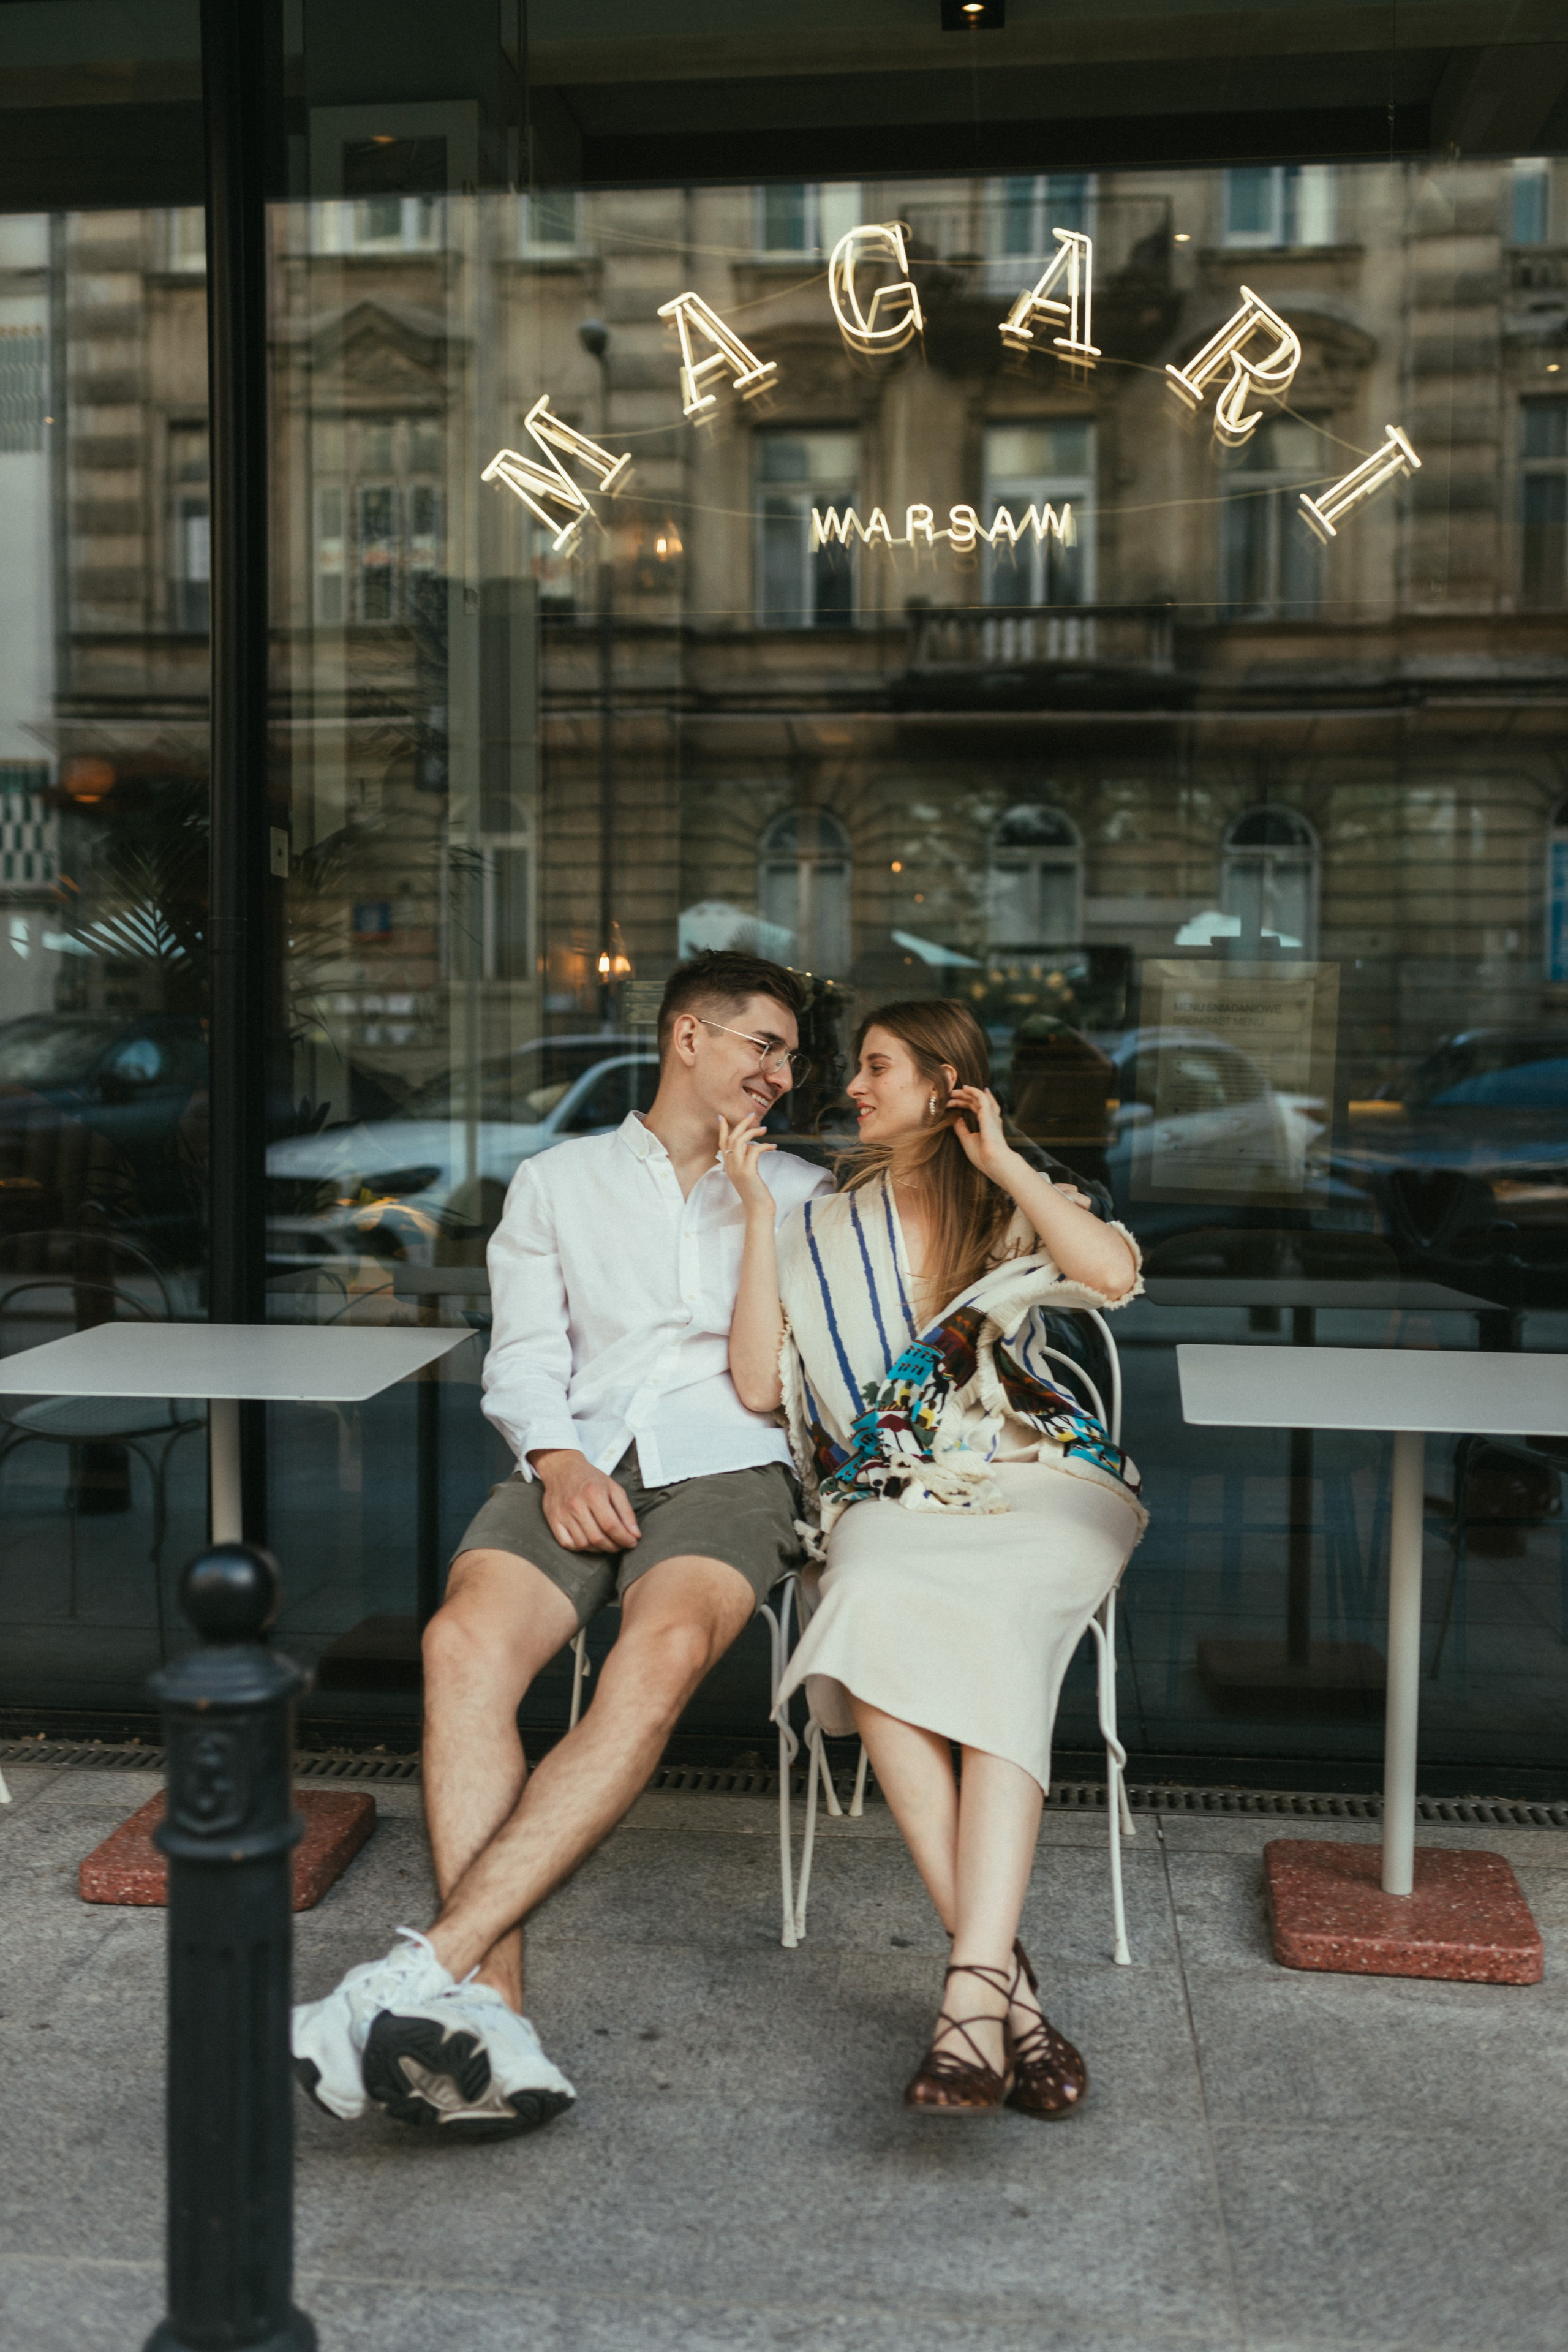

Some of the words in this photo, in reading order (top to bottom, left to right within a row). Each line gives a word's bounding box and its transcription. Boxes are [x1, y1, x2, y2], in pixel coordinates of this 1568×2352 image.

[481, 225, 1421, 554] MAGARI
[812, 503, 1071, 544] WARSAW
[1174, 1002, 1205, 1012] MENU
